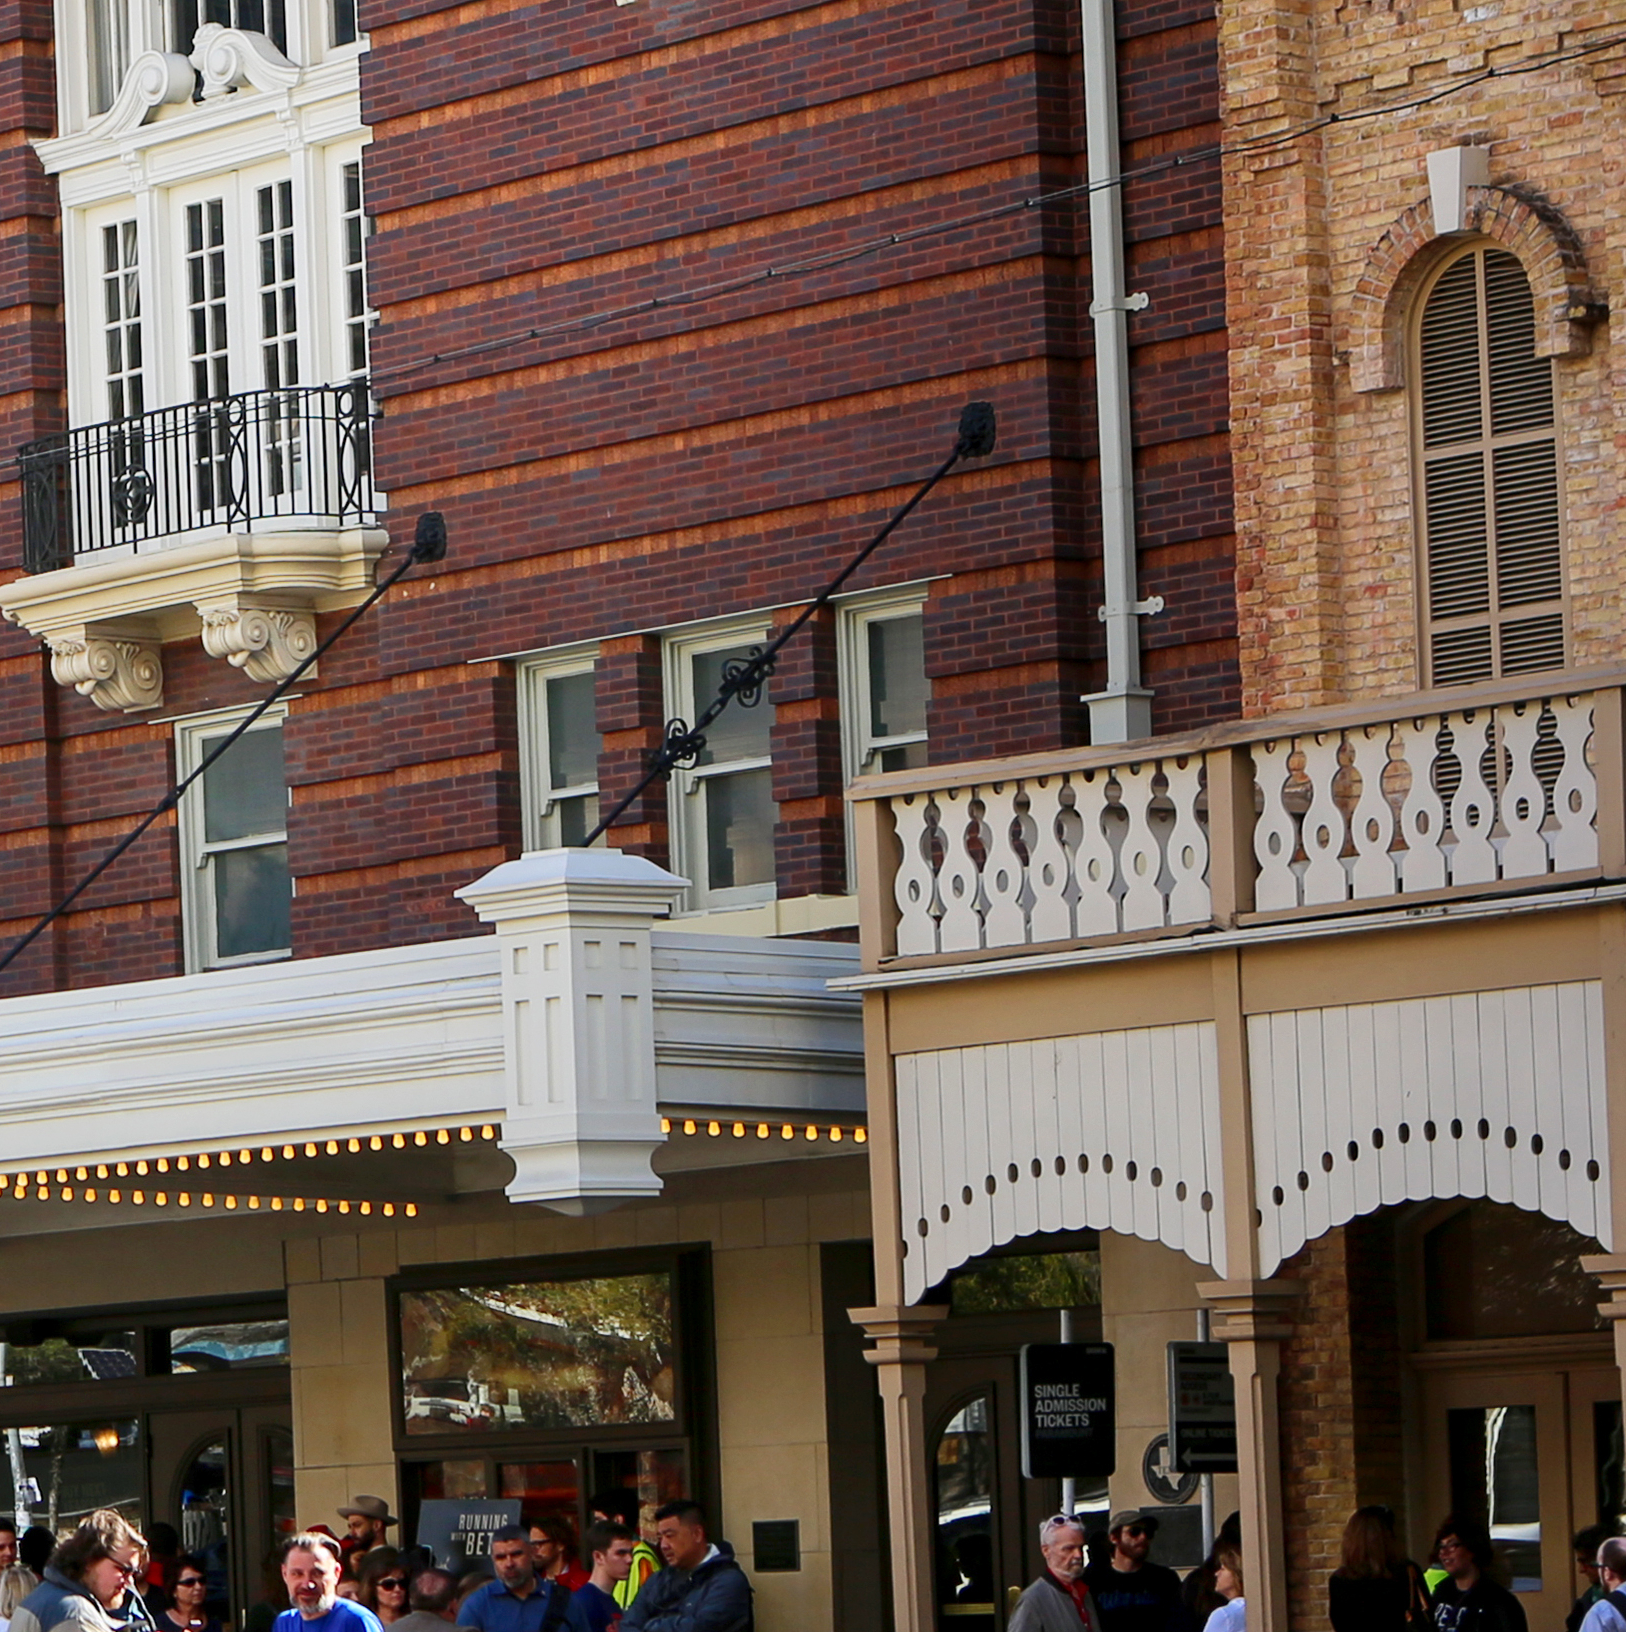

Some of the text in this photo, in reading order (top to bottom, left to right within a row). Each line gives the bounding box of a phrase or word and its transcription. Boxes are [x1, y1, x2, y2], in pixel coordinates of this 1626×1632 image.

[1034, 1383, 1081, 1399] SINGLE
[1034, 1398, 1107, 1413] ADMISSION
[1036, 1413, 1090, 1428] TICKETS
[458, 1513, 509, 1531] RUNNING
[465, 1531, 495, 1556] BET
